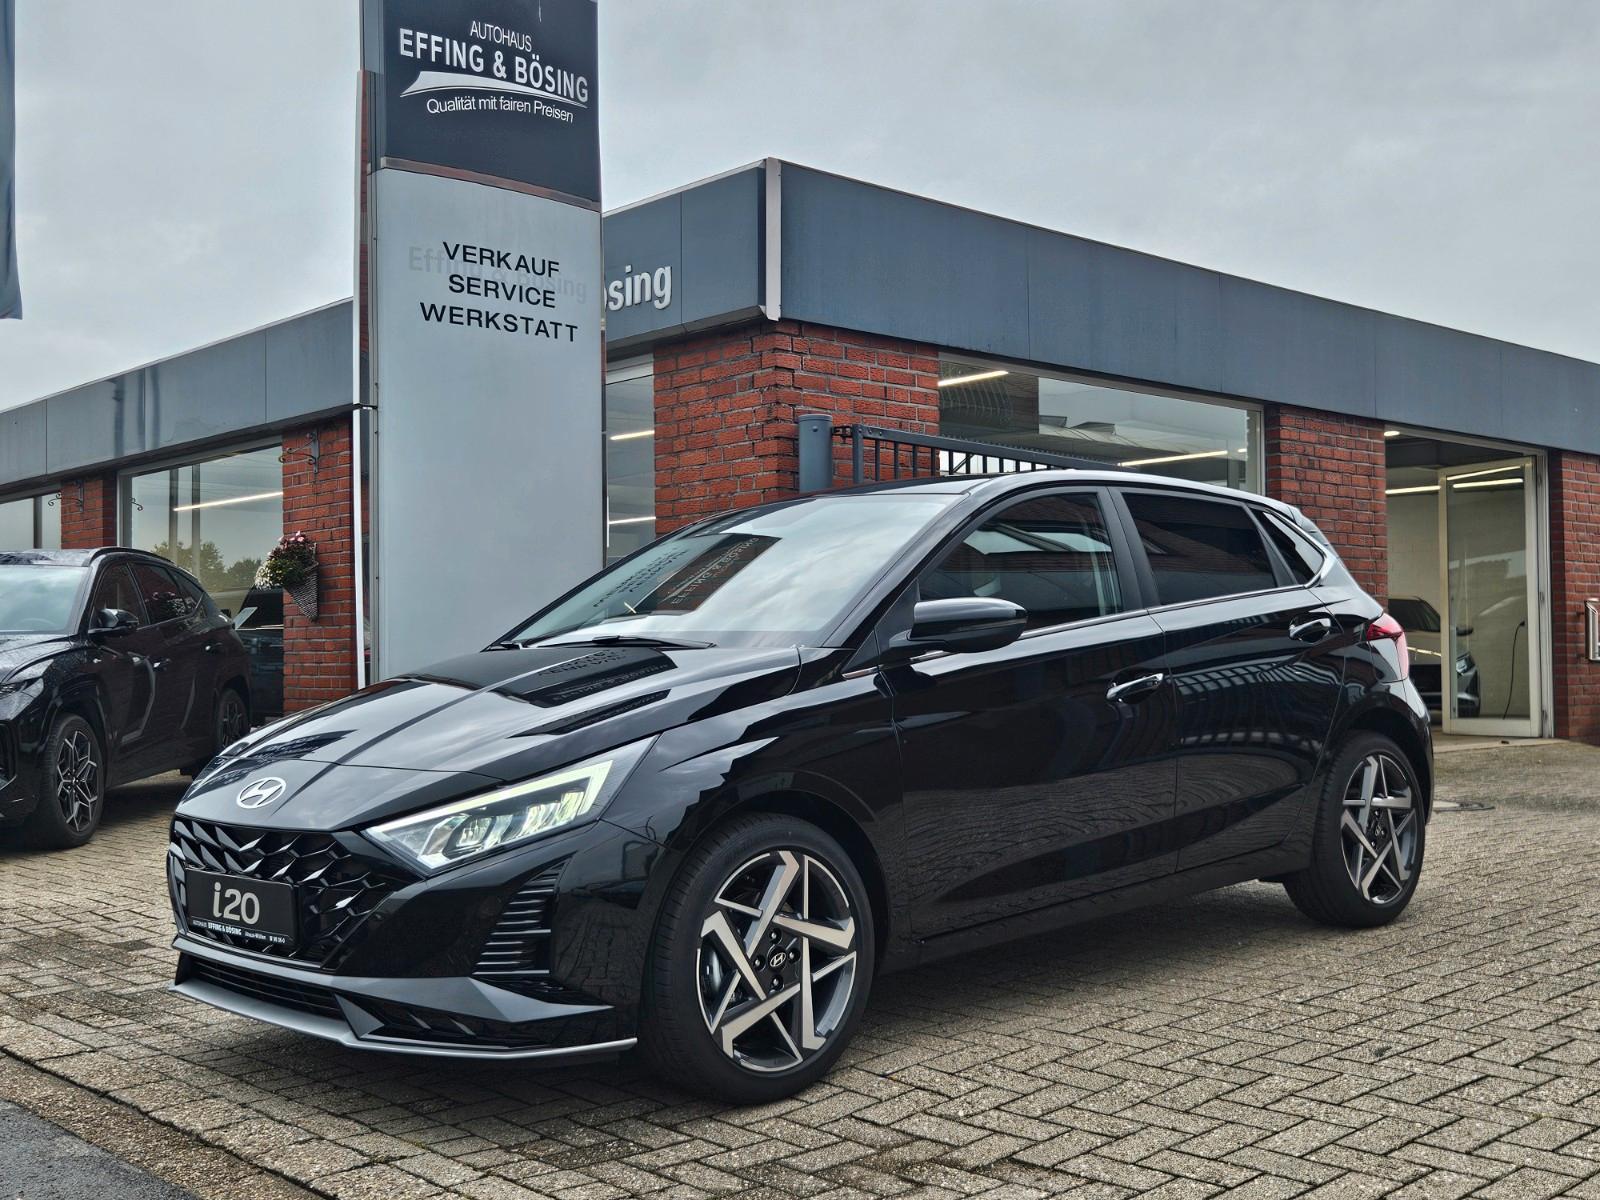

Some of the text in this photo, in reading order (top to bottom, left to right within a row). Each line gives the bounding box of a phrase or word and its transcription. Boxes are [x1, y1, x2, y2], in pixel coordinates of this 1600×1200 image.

[470, 20, 532, 52] AUTOHAUS
[400, 28, 589, 103] EFFING & BÖSING
[426, 96, 574, 124] Qualität mit fairen Preisen
[443, 241, 560, 278] VERKAUF
[448, 273, 556, 309] SERVICE
[604, 265, 672, 311] sing
[419, 301, 579, 342] WERKSTATT
[213, 881, 260, 925] i20
